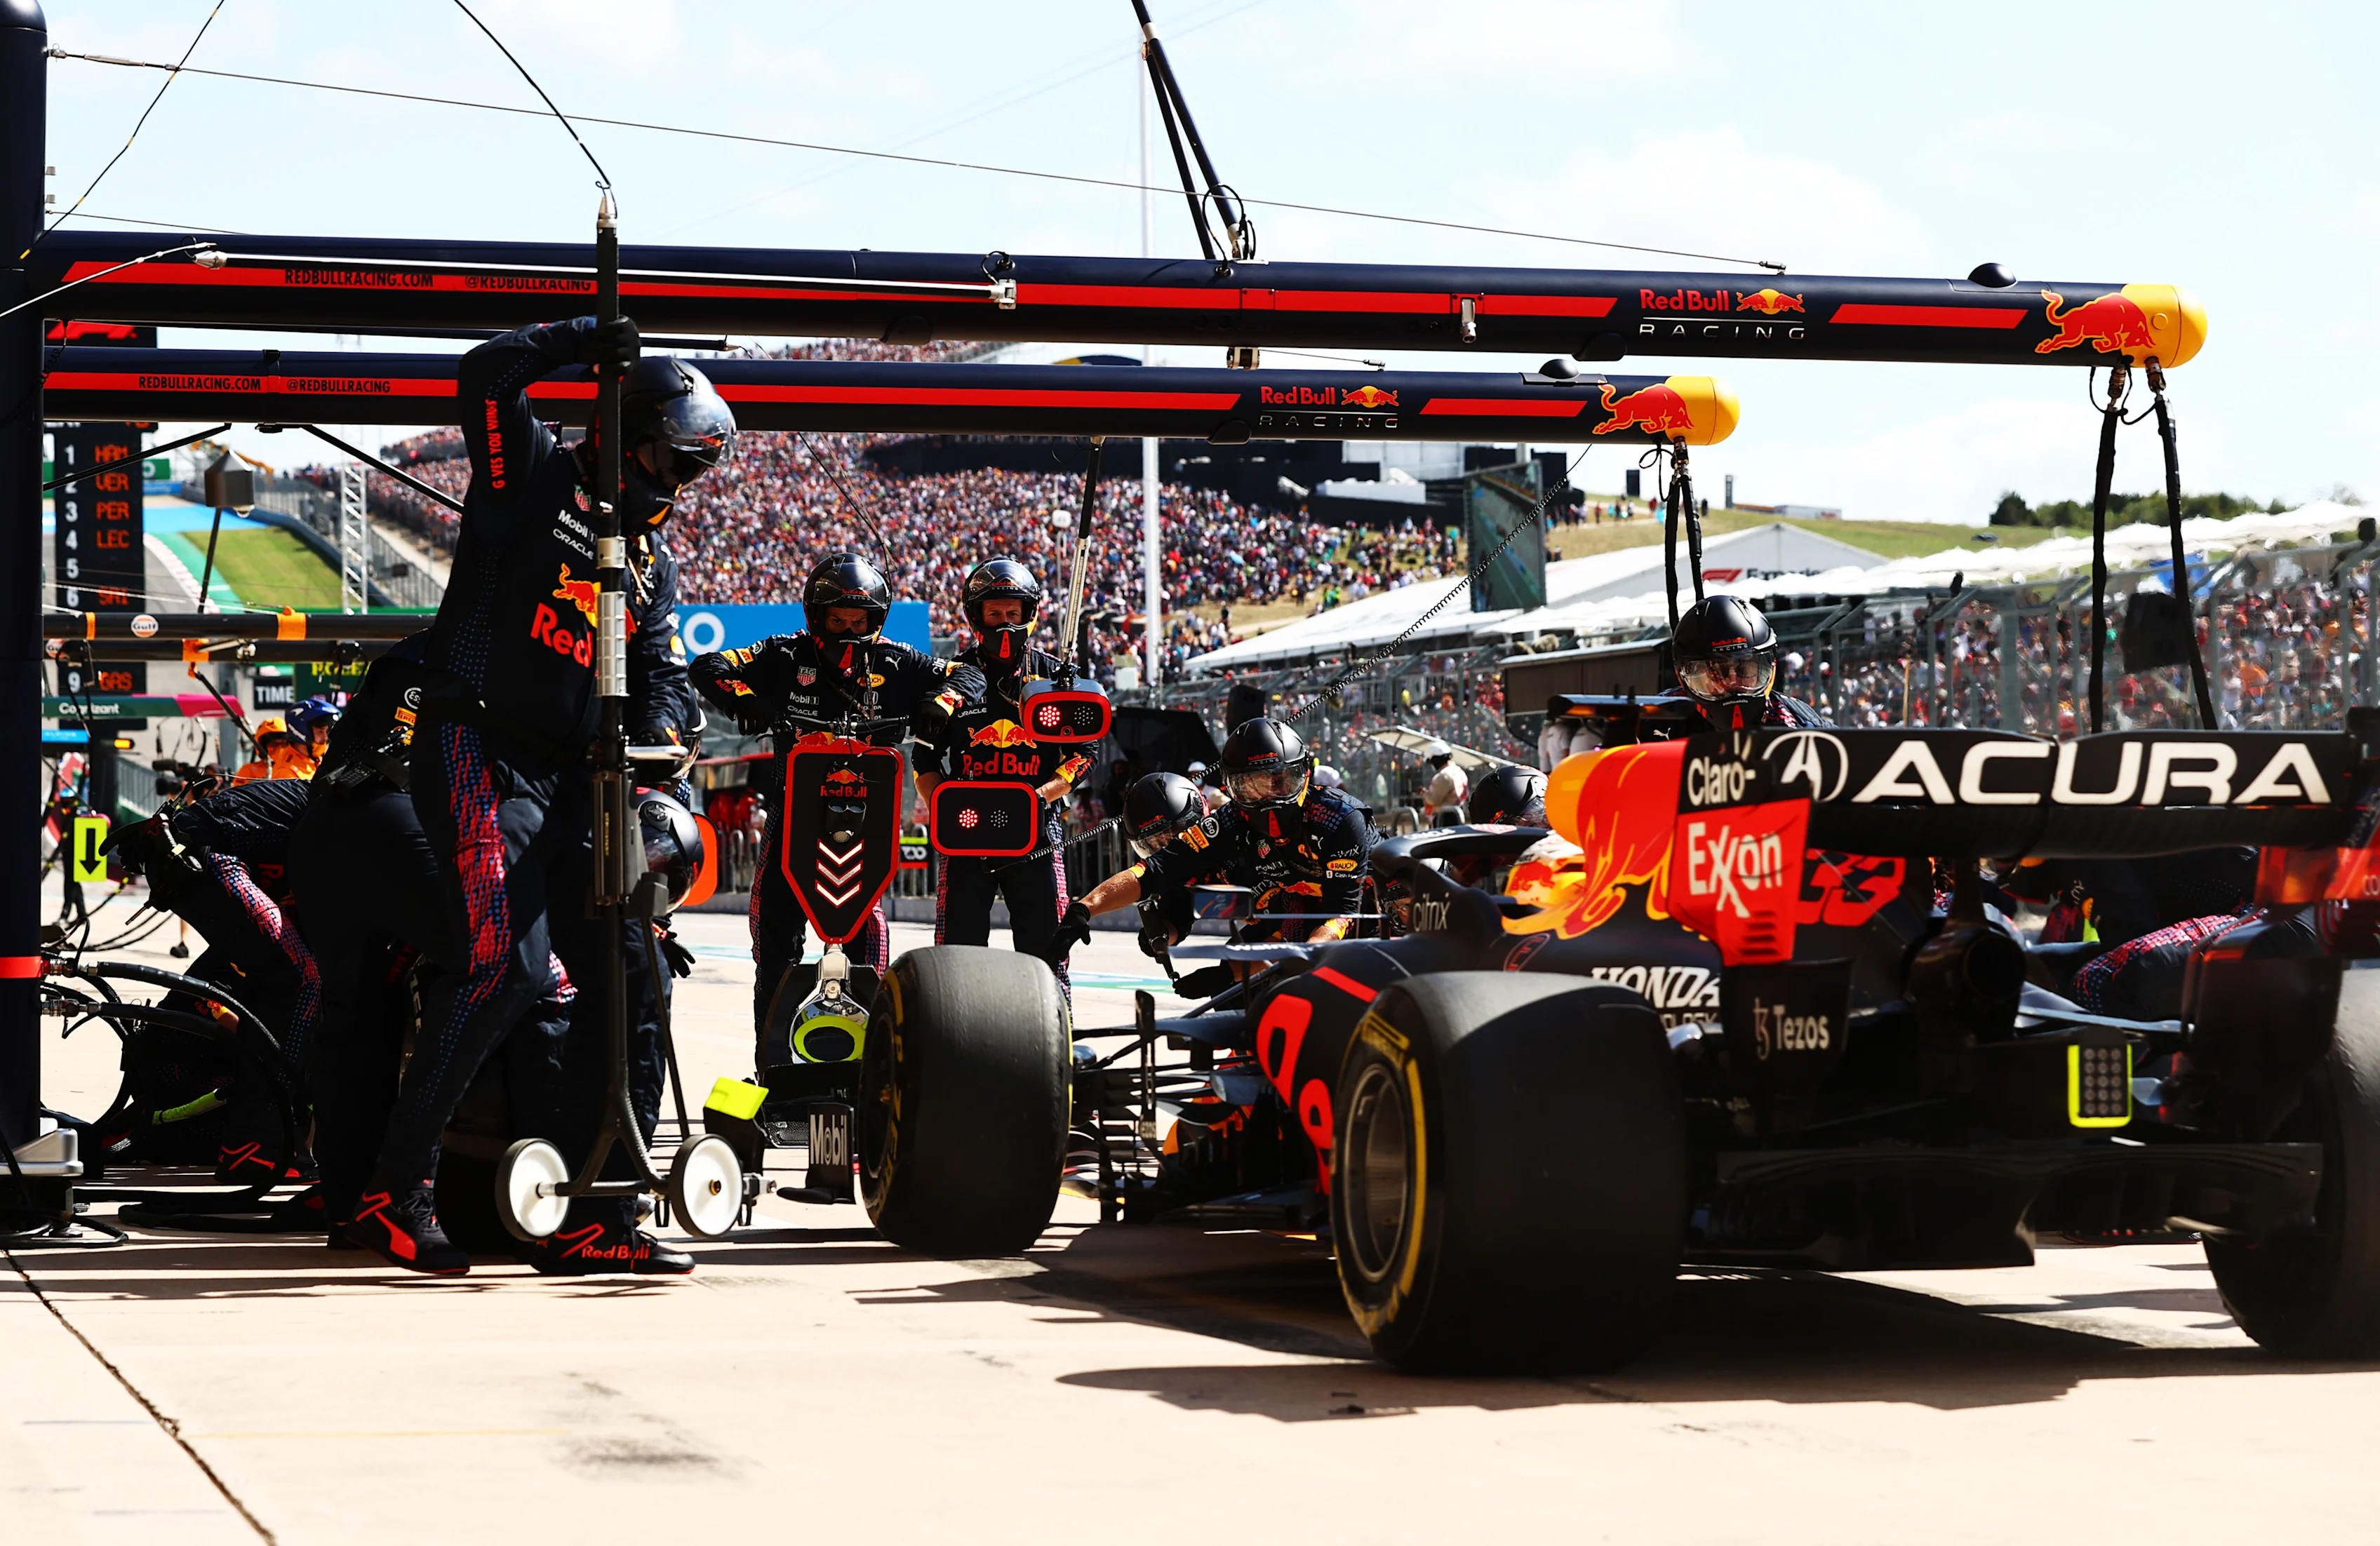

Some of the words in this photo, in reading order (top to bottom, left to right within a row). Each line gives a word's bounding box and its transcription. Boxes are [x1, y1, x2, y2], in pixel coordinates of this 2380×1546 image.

[285, 269, 433, 288] REDBULLRACING.COM
[465, 275, 591, 291] @REDBULLRACING
[1639, 288, 1683, 309] Red
[1686, 290, 1730, 311] Bull
[1639, 324, 1805, 339] RACING
[139, 376, 260, 390] REDBULLRACING.COM
[286, 379, 391, 392] @REDBULLRACING
[1260, 386, 1297, 404] Red
[1300, 387, 1335, 405] Bull
[1259, 415, 1398, 428] RACING
[488, 433, 502, 455] YOU
[65, 445, 74, 465] 1
[95, 473, 129, 491] VER
[65, 501, 78, 522] 3
[96, 501, 130, 520] PER
[558, 509, 588, 538] Mobil
[65, 530, 78, 550] 4
[96, 530, 130, 549] LEC
[552, 527, 595, 560] ORACLE
[67, 558, 79, 578] 5
[67, 586, 79, 607] 6
[133, 621, 157, 631] Gulf
[530, 602, 594, 668] Red
[800, 667, 815, 675] TAG
[68, 671, 81, 693] 9
[99, 671, 133, 691] GAS
[255, 685, 295, 703] TIME
[789, 692, 810, 704] Mobil
[787, 705, 818, 716] ORACLE
[962, 752, 998, 777] Red
[1002, 753, 1041, 776] Bull
[1851, 740, 2331, 805] ACURA
[1687, 755, 1745, 806] Claro
[820, 785, 843, 797] Red
[845, 786, 867, 798] Bull
[1687, 821, 1783, 918] Exxon
[1772, 1004, 1831, 1050] Tezos
[810, 1114, 847, 1166] Mobil
[581, 1244, 617, 1258] Red
[617, 1244, 650, 1260] Bull
